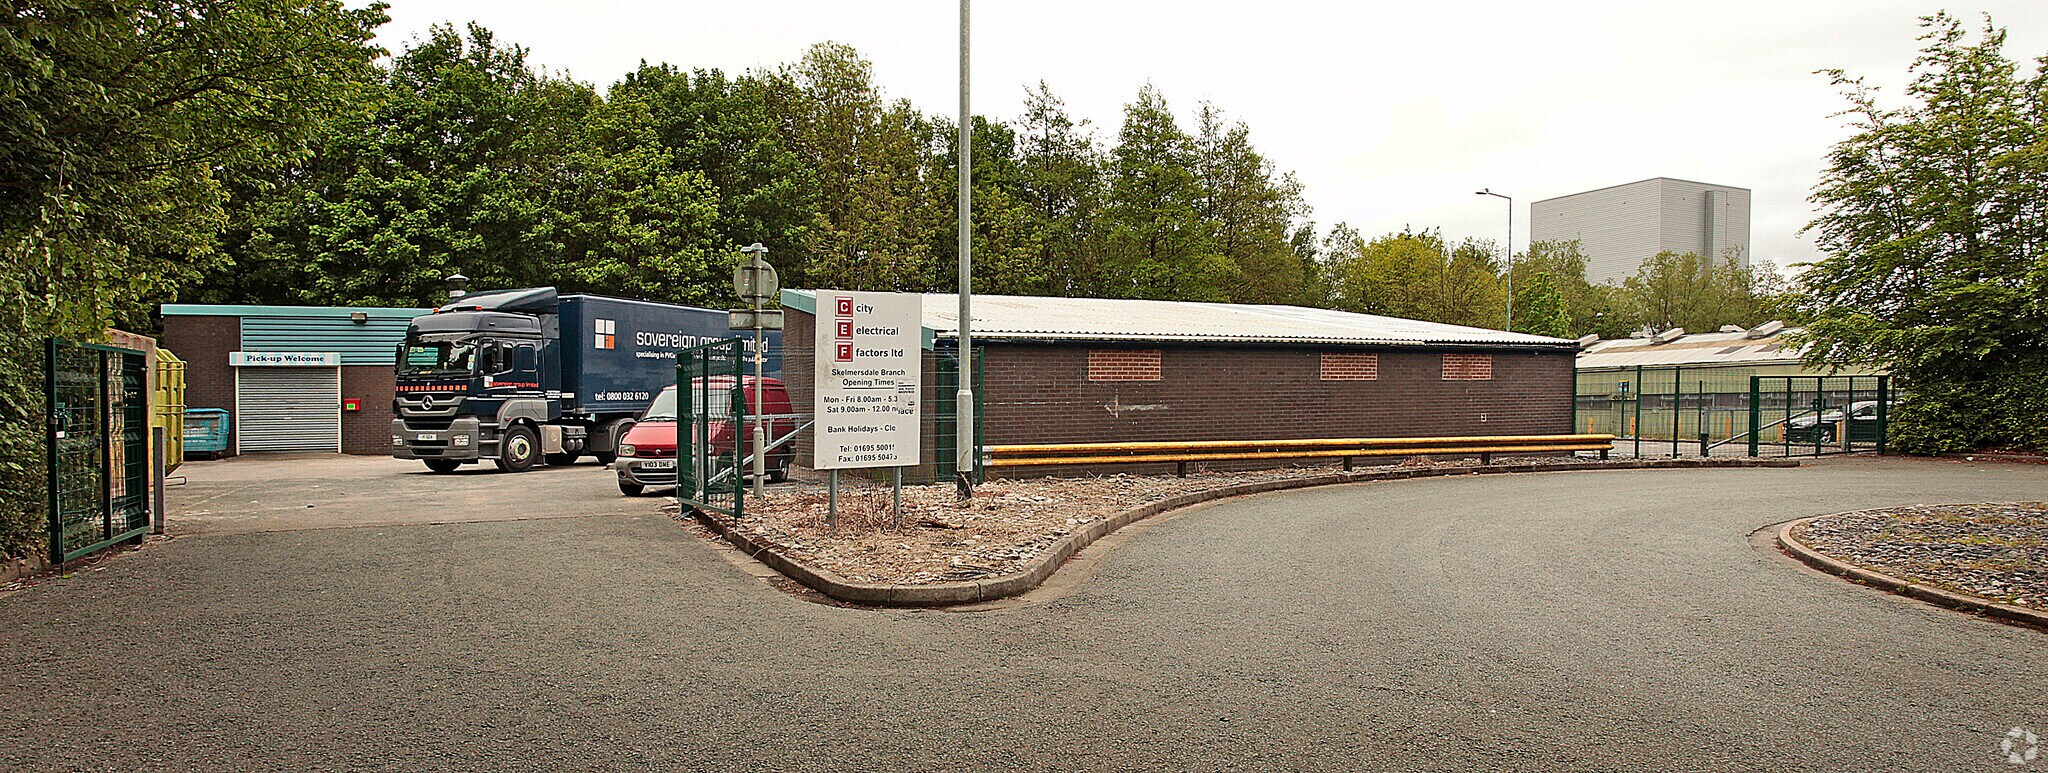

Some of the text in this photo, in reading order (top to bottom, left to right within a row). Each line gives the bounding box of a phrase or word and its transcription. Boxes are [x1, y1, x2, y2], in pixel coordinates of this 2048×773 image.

[856, 303, 874, 315] city
[856, 326, 899, 336] electrical
[636, 330, 696, 350] sovereign
[856, 348, 889, 357] factors
[891, 348, 904, 357] ltd
[246, 355, 282, 363] Pick-up
[831, 368, 906, 376] Skelmersdale Branch
[842, 378, 873, 387] Opening
[874, 378, 895, 386] Times
[594, 392, 649, 401] tel: 0800 032 6120
[857, 395, 882, 403] 8.00am
[847, 425, 878, 433] Holidays
[853, 444, 874, 452] 01695
[855, 454, 876, 462] 01695
